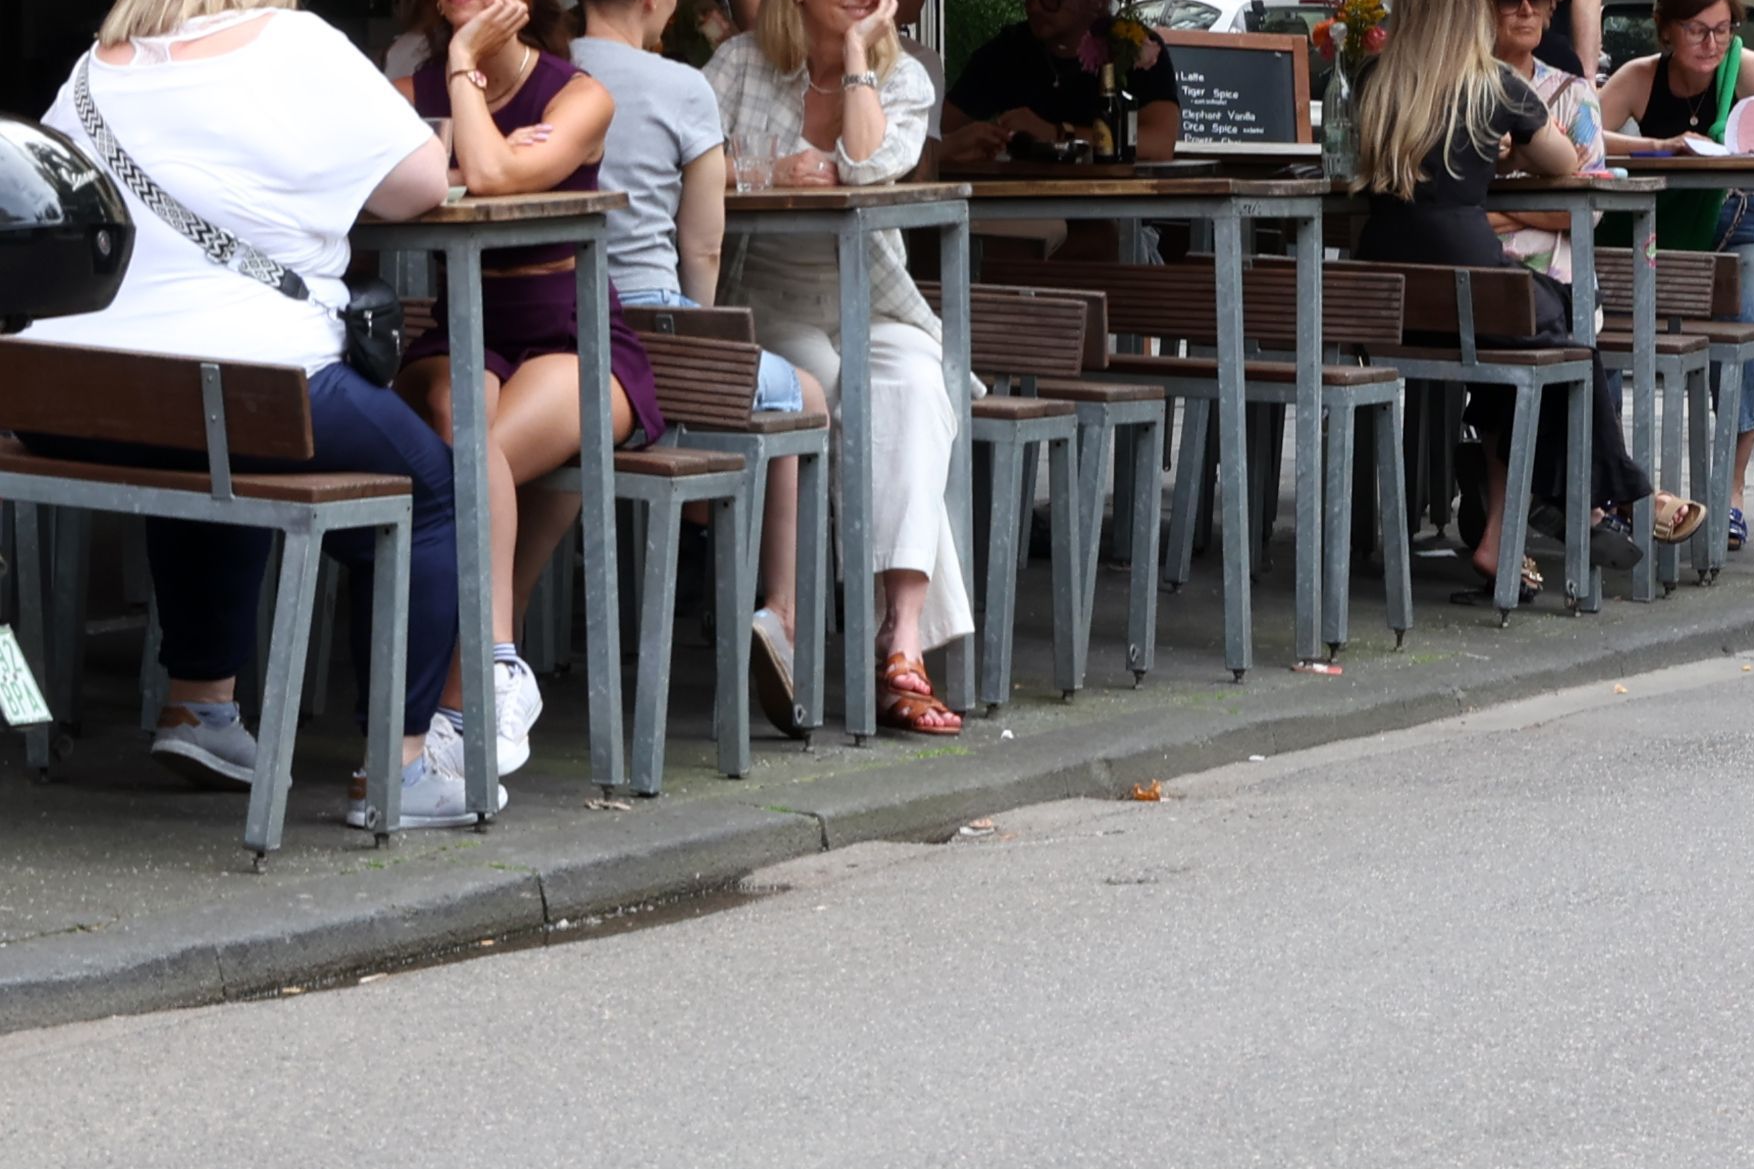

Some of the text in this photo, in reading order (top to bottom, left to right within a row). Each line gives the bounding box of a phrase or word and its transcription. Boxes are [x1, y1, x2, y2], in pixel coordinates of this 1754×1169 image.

[1180, 71, 1205, 82] Latte
[1181, 85, 1239, 100] Tiger Spice
[1182, 108, 1256, 122] Elephant Vanilla
[1183, 121, 1205, 132] Orca
[1211, 122, 1238, 135] Spice
